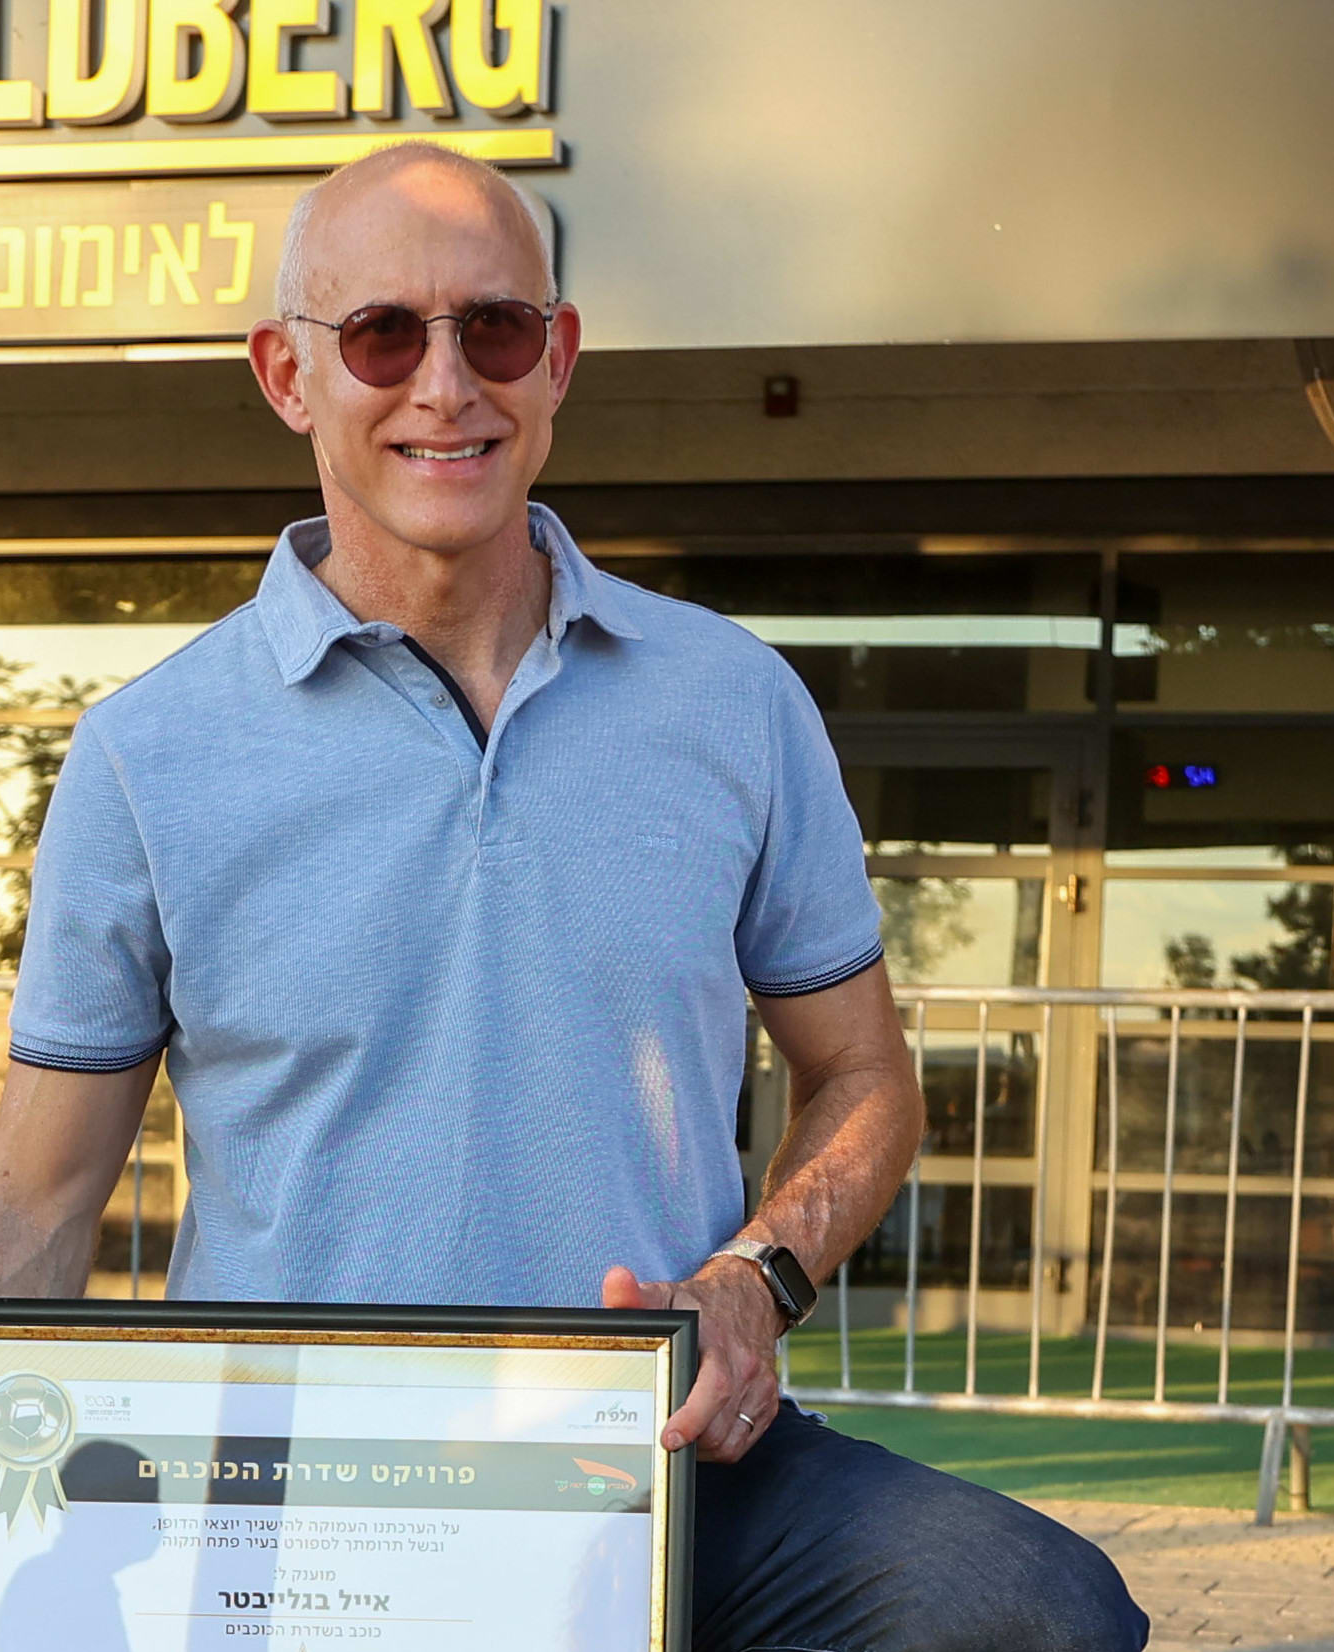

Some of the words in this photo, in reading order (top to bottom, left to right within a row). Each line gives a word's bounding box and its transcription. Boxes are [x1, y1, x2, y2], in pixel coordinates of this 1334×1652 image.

[138, 1459, 260, 1481] הכוכבים
[272, 1462, 358, 1482] שדרת
[370, 1463, 477, 1488] פרויקט
[152, 1518, 199, 1532] הדופן,
[203, 1518, 240, 1531] יוצאי
[308, 1520, 369, 1534] העמוקה
[373, 1521, 437, 1535] הערכתנו
[441, 1520, 460, 1535] על
[162, 1535, 201, 1549] תקוה
[206, 1536, 240, 1549] פתח
[245, 1537, 278, 1549] בעיר
[284, 1537, 340, 1551] לספורט
[346, 1539, 404, 1553] תרומתך
[408, 1538, 444, 1553] ובשל
[291, 1569, 337, 1583] מוענק
[218, 1588, 331, 1611] בגלייבטר
[338, 1588, 390, 1612] אייל
[225, 1622, 286, 1637] הכוכבים
[290, 1624, 344, 1638] בשדרת
[349, 1625, 382, 1639] כוכב
